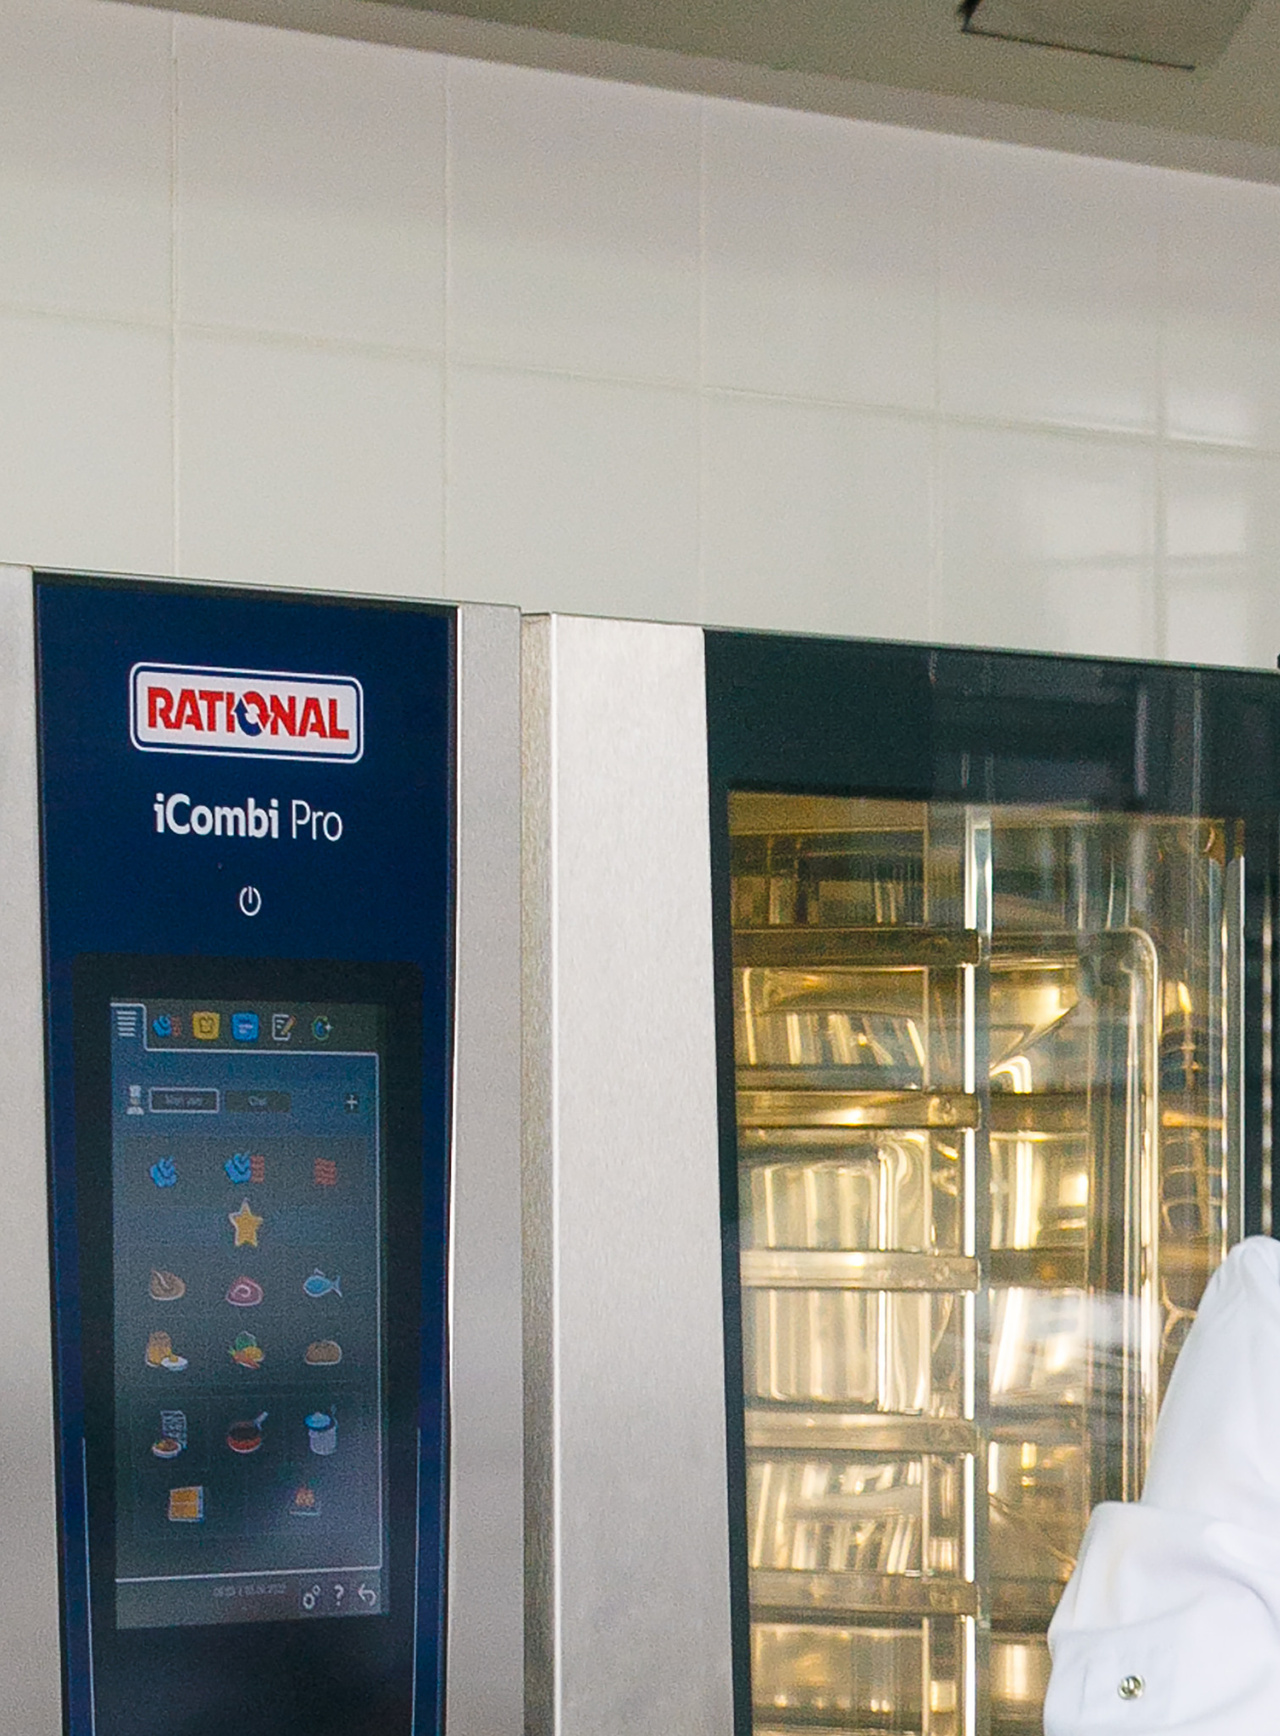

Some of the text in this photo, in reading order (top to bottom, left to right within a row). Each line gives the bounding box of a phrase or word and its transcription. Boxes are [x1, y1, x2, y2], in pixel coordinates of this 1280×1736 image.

[146, 686, 350, 740] RATIONAL
[153, 792, 343, 842] iCombi Pro
